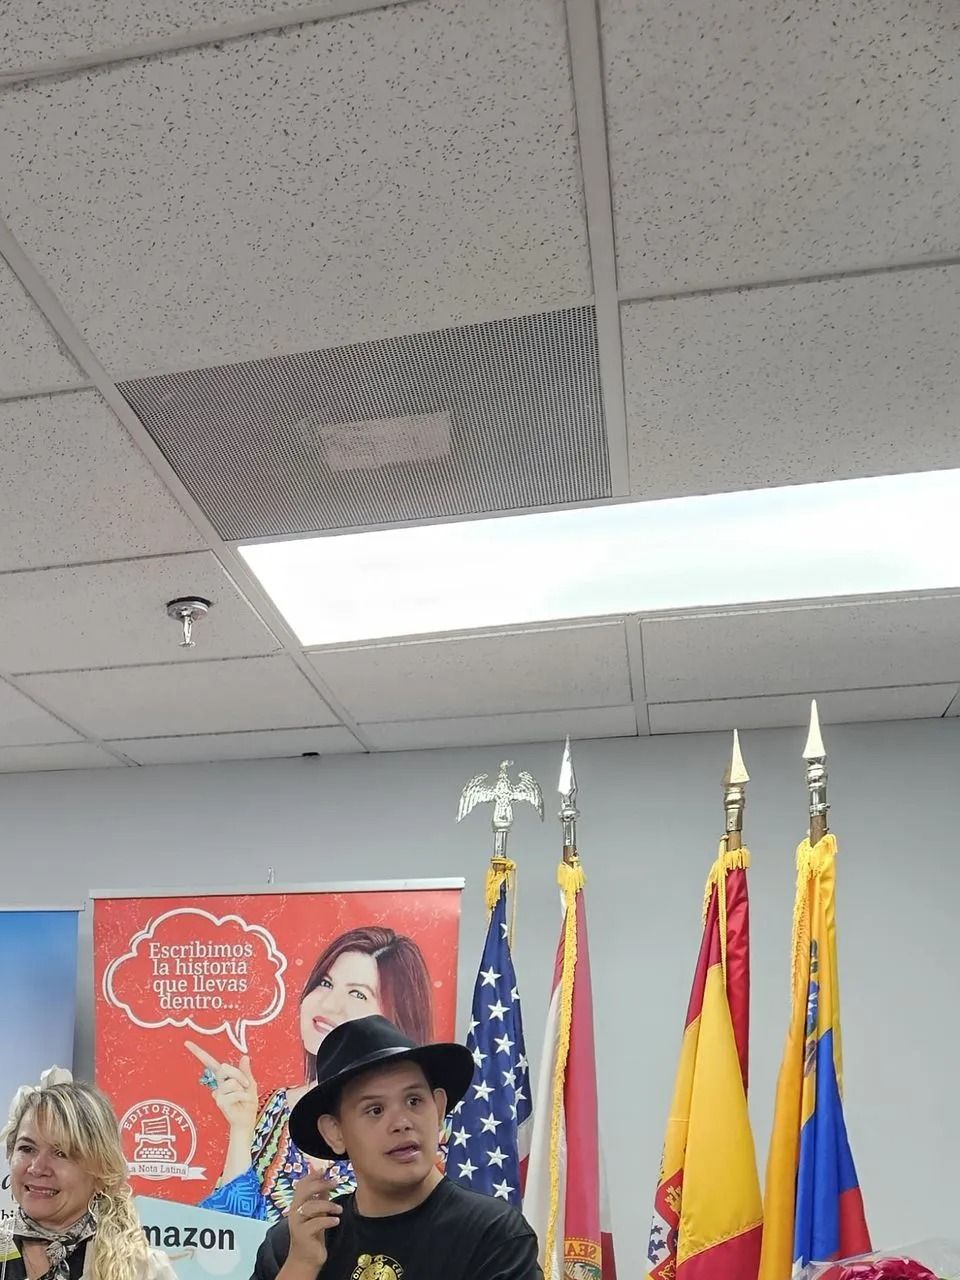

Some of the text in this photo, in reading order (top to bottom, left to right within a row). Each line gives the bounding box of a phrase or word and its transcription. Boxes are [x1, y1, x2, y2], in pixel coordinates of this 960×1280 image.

[149, 940, 253, 959] Escribimos
[152, 958, 248, 976] la historia
[153, 975, 248, 997] que llevas
[160, 993, 239, 1009] dentro...
[123, 1105, 190, 1132] EDITORIAL
[138, 1164, 158, 1173] Nota
[160, 1164, 187, 1175] Latina
[142, 1225, 235, 1251] mazon
